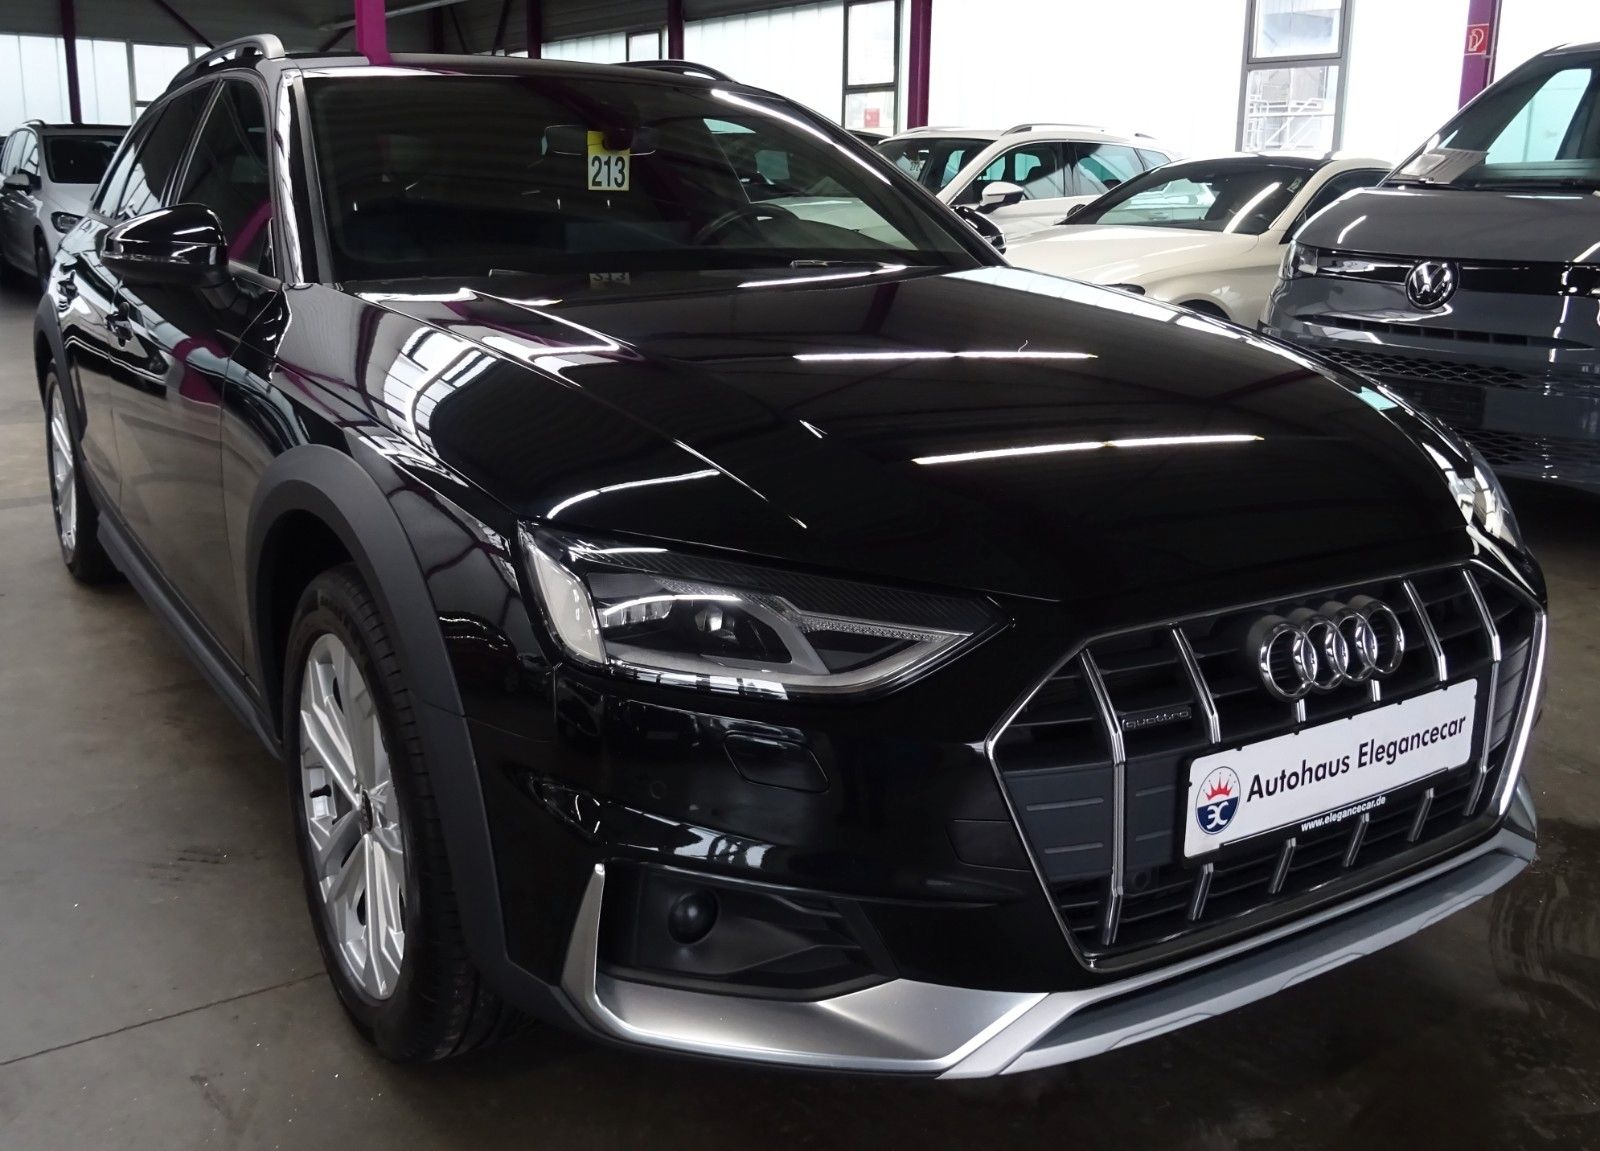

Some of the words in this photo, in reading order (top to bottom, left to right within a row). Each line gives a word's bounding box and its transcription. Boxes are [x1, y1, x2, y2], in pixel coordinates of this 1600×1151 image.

[591, 155, 626, 188] 213
[1247, 755, 1350, 802] Autohaus
[1358, 716, 1466, 768] Elegancecar
[1301, 795, 1386, 832] www.elegancecar.de
